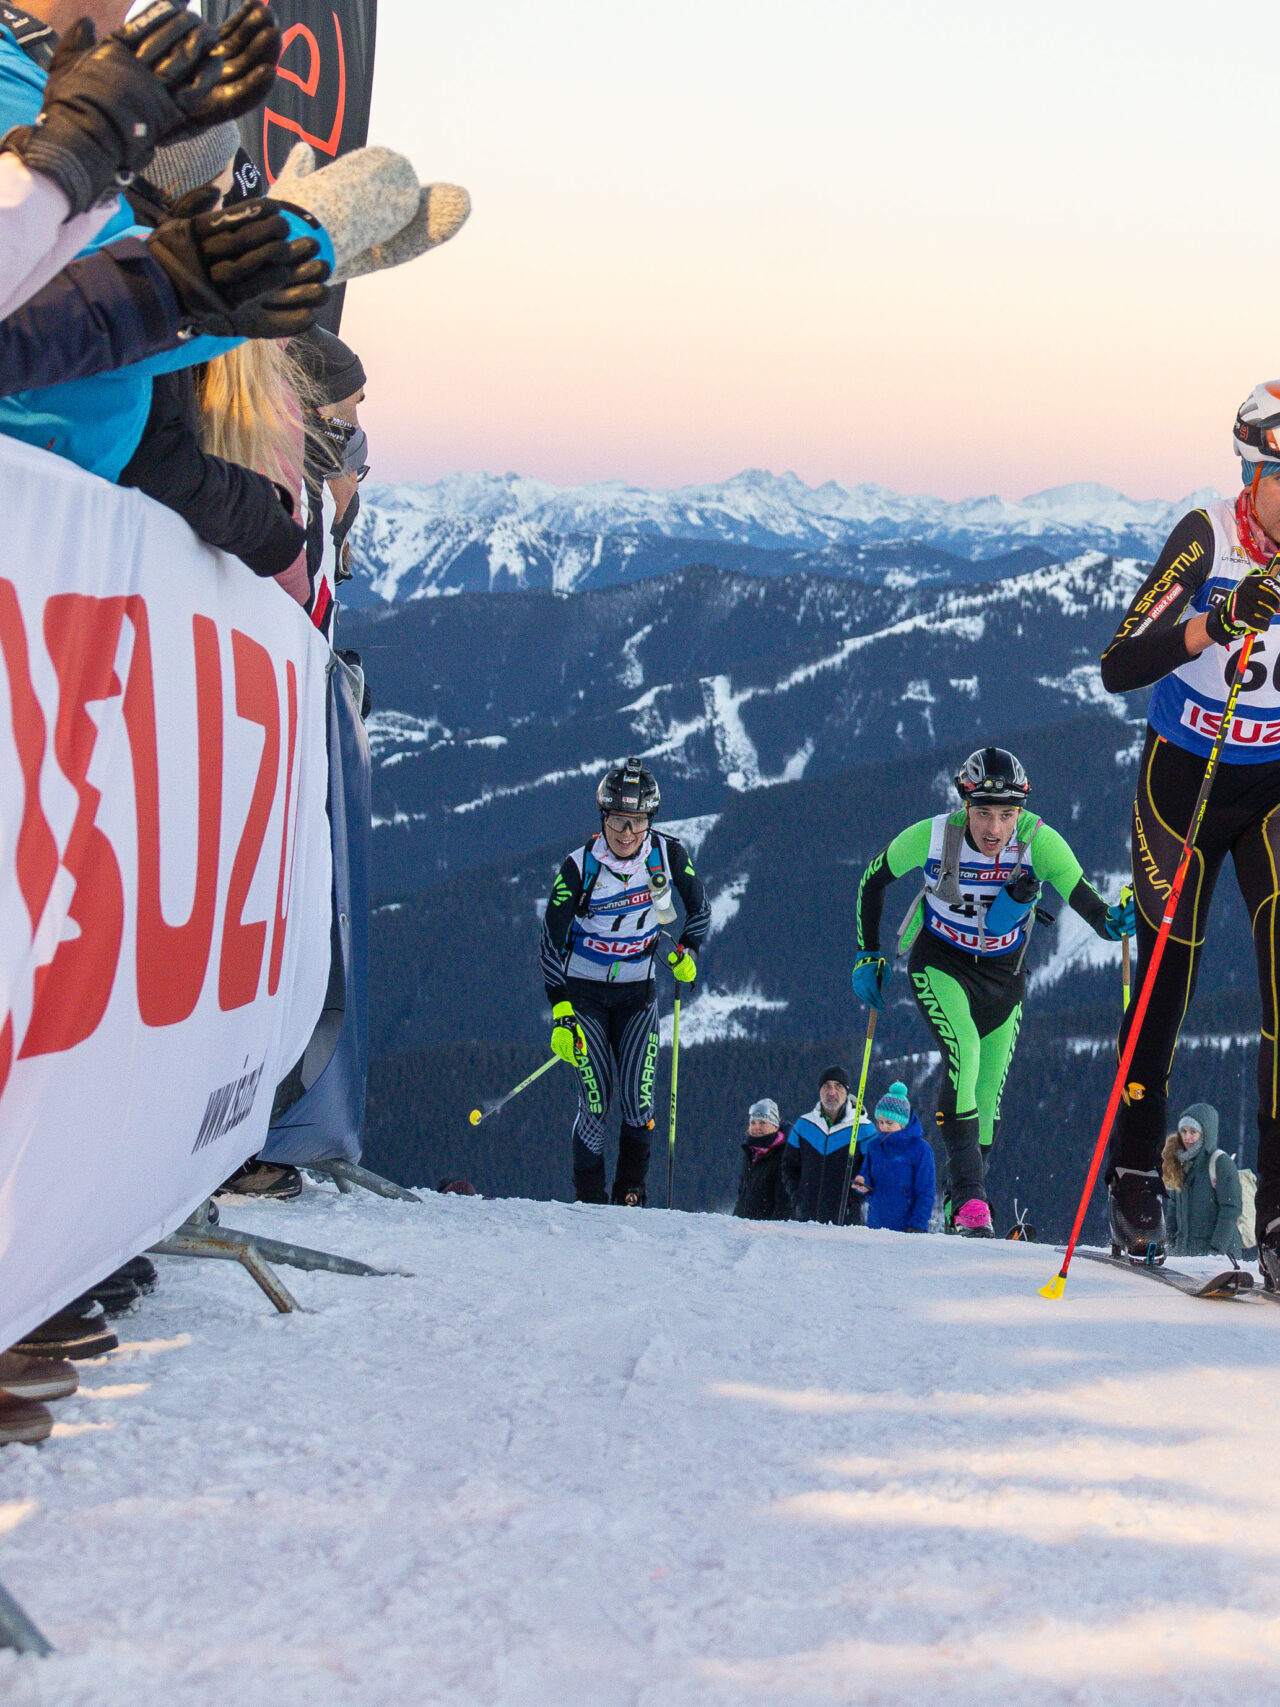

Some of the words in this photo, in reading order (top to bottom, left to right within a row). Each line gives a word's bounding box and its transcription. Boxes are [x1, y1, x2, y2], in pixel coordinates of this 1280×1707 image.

[1134, 541, 1205, 614] SPORTIVA
[936, 920, 1016, 950] ISUZU
[911, 972, 960, 1091] DYNAFIT
[640, 1032, 659, 1109] KARPOS
